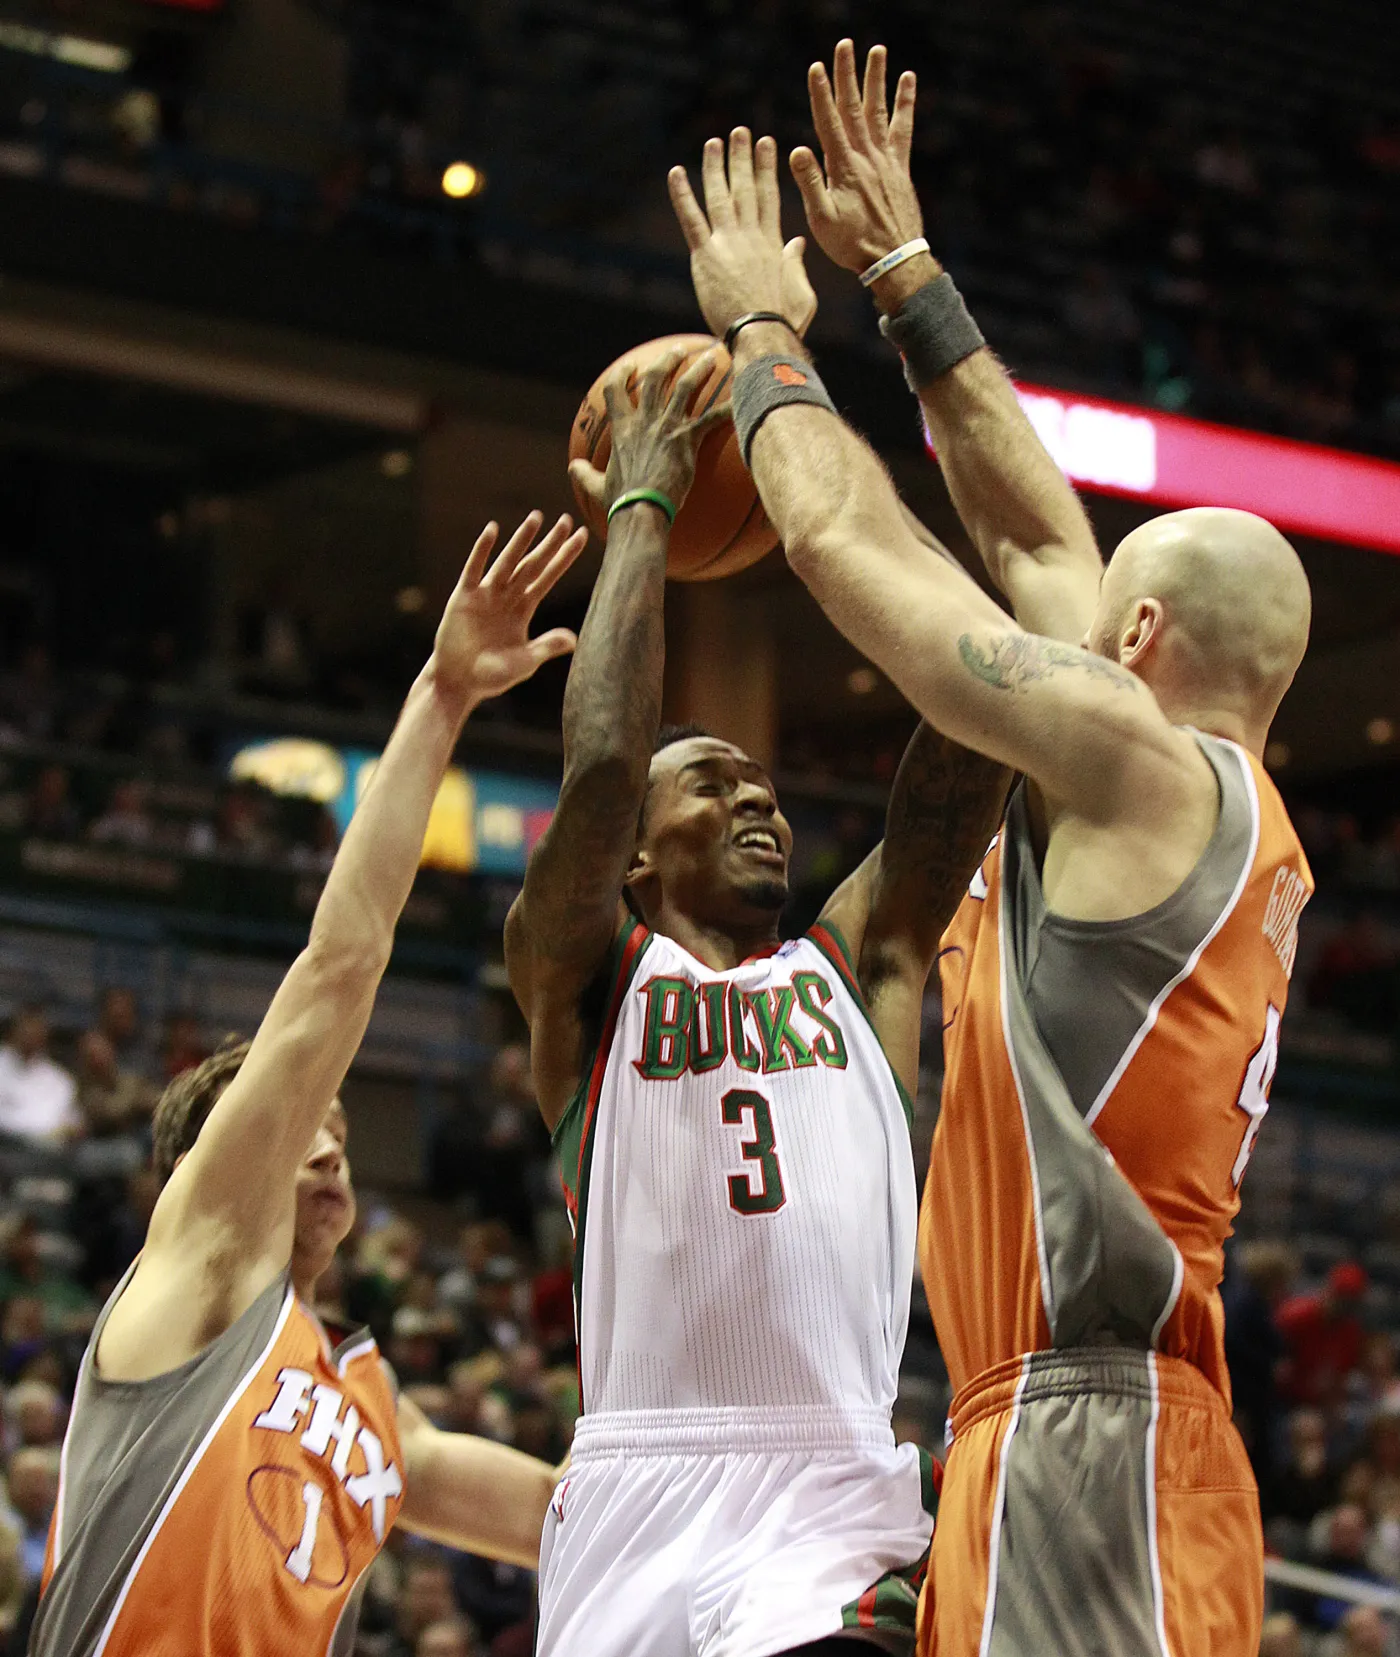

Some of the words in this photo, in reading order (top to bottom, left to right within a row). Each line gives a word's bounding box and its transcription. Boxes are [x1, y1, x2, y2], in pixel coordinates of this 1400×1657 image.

[632, 970, 848, 1080] BUCKS
[720, 1088, 786, 1215] 3
[1231, 1002, 1281, 1188] 4
[250, 1367, 403, 1545] PHX
[284, 1480, 324, 1584] 1
